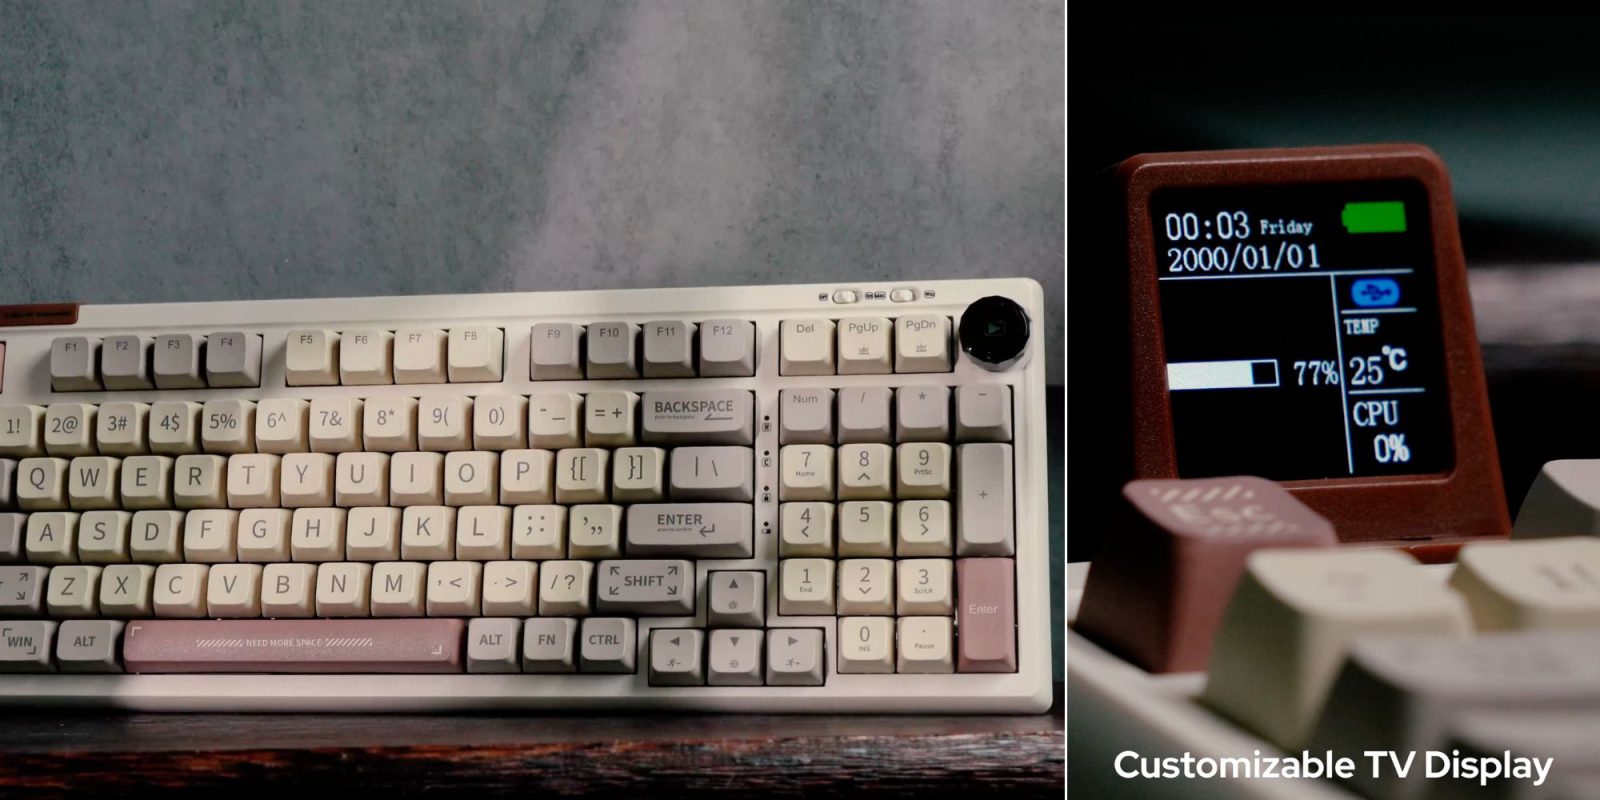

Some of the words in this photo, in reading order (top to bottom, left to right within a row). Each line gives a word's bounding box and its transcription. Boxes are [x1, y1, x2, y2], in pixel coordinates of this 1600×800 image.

[1165, 211, 1251, 241] 00:03
[1260, 219, 1313, 237] Friday
[1167, 241, 1320, 272] 2000/01/01
[600, 328, 619, 338] F10
[657, 327, 675, 337] F11
[713, 326, 733, 336] F12
[796, 324, 815, 333] Del
[848, 323, 879, 333] PgUp
[906, 320, 936, 330] PgDn
[1344, 319, 1380, 335] TEMP
[221, 337, 233, 347] F4
[300, 335, 313, 344] F5
[355, 335, 368, 345] F6
[409, 334, 421, 343] F7
[464, 332, 477, 341] F8
[547, 329, 561, 339] F9
[65, 342, 77, 352] F1
[116, 341, 129, 351] F2
[168, 340, 180, 350] F3
[1293, 360, 1339, 386] 77%
[655, 400, 734, 413] BACKSPACE
[793, 394, 818, 404] Num
[209, 413, 237, 430] 5%
[267, 412, 287, 428] 6^
[319, 411, 342, 427] 7&
[432, 407, 449, 427] 9(
[488, 407, 505, 426] 0)
[1353, 401, 1399, 426] CPU
[7, 419, 20, 434] 1!
[52, 416, 79, 434] 2@
[107, 416, 129, 431] 3#
[160, 414, 180, 432] 4$
[1374, 434, 1410, 463] 0%
[801, 451, 812, 468] 7
[859, 451, 870, 467] 8
[918, 450, 929, 466] 9
[30, 467, 45, 490] Q
[80, 468, 100, 487] W
[136, 468, 147, 486] E
[189, 467, 203, 486] R
[242, 465, 255, 485] T
[296, 464, 309, 484] Y
[350, 464, 365, 483] U
[410, 463, 414, 483] I
[458, 463, 475, 483] O
[517, 461, 530, 480] P
[657, 514, 703, 525] ENTER
[801, 508, 812, 523] 4
[859, 507, 870, 523] 5
[918, 506, 929, 522] 6
[39, 523, 53, 542] A
[93, 522, 106, 540] S
[145, 523, 159, 541] D
[200, 520, 213, 539] F
[252, 520, 267, 538] G
[305, 519, 320, 538] H
[363, 518, 376, 537] J
[416, 517, 431, 536] K
[472, 517, 485, 536] L
[624, 575, 664, 587] SHIFT
[802, 568, 811, 584] 1
[859, 567, 871, 582] 2
[918, 569, 929, 585] 3
[61, 577, 76, 595] Z
[114, 576, 129, 594] X
[168, 576, 182, 594] C
[223, 576, 238, 594] V
[275, 575, 290, 594] B
[331, 574, 347, 593] N
[385, 574, 402, 593] M
[969, 604, 998, 614] Enter
[8, 636, 33, 647] WIN
[73, 636, 96, 647] ALT
[479, 634, 503, 645] ALT
[538, 634, 556, 645] FN
[589, 634, 620, 645] CTRL
[859, 626, 870, 642] 0
[246, 639, 268, 647] NEED
[270, 639, 294, 647] MORE
[296, 638, 322, 647] SPACE
